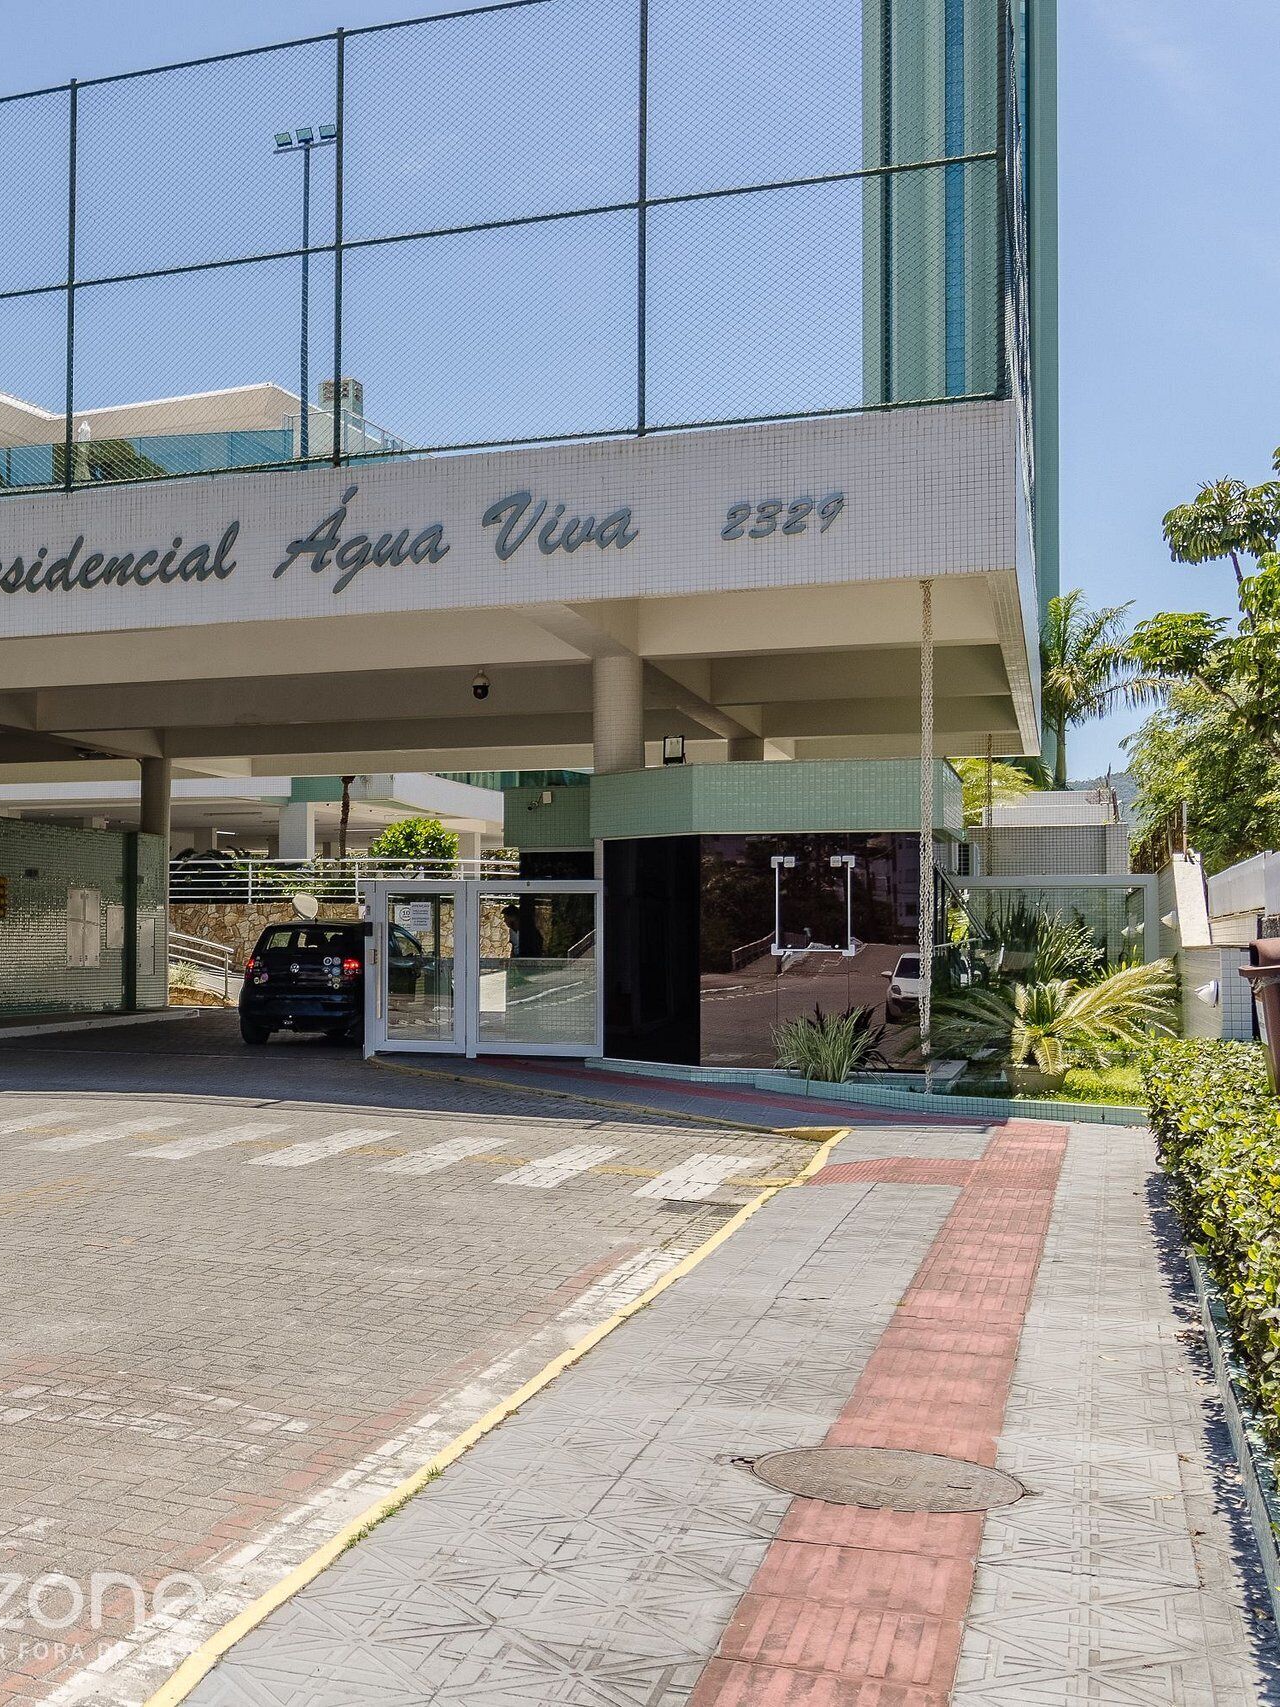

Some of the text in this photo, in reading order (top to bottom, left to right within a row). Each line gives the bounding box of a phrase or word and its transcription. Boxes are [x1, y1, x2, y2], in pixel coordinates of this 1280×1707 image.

[272, 485, 452, 596] Água
[482, 490, 640, 562] Viva
[720, 490, 846, 542] 2329
